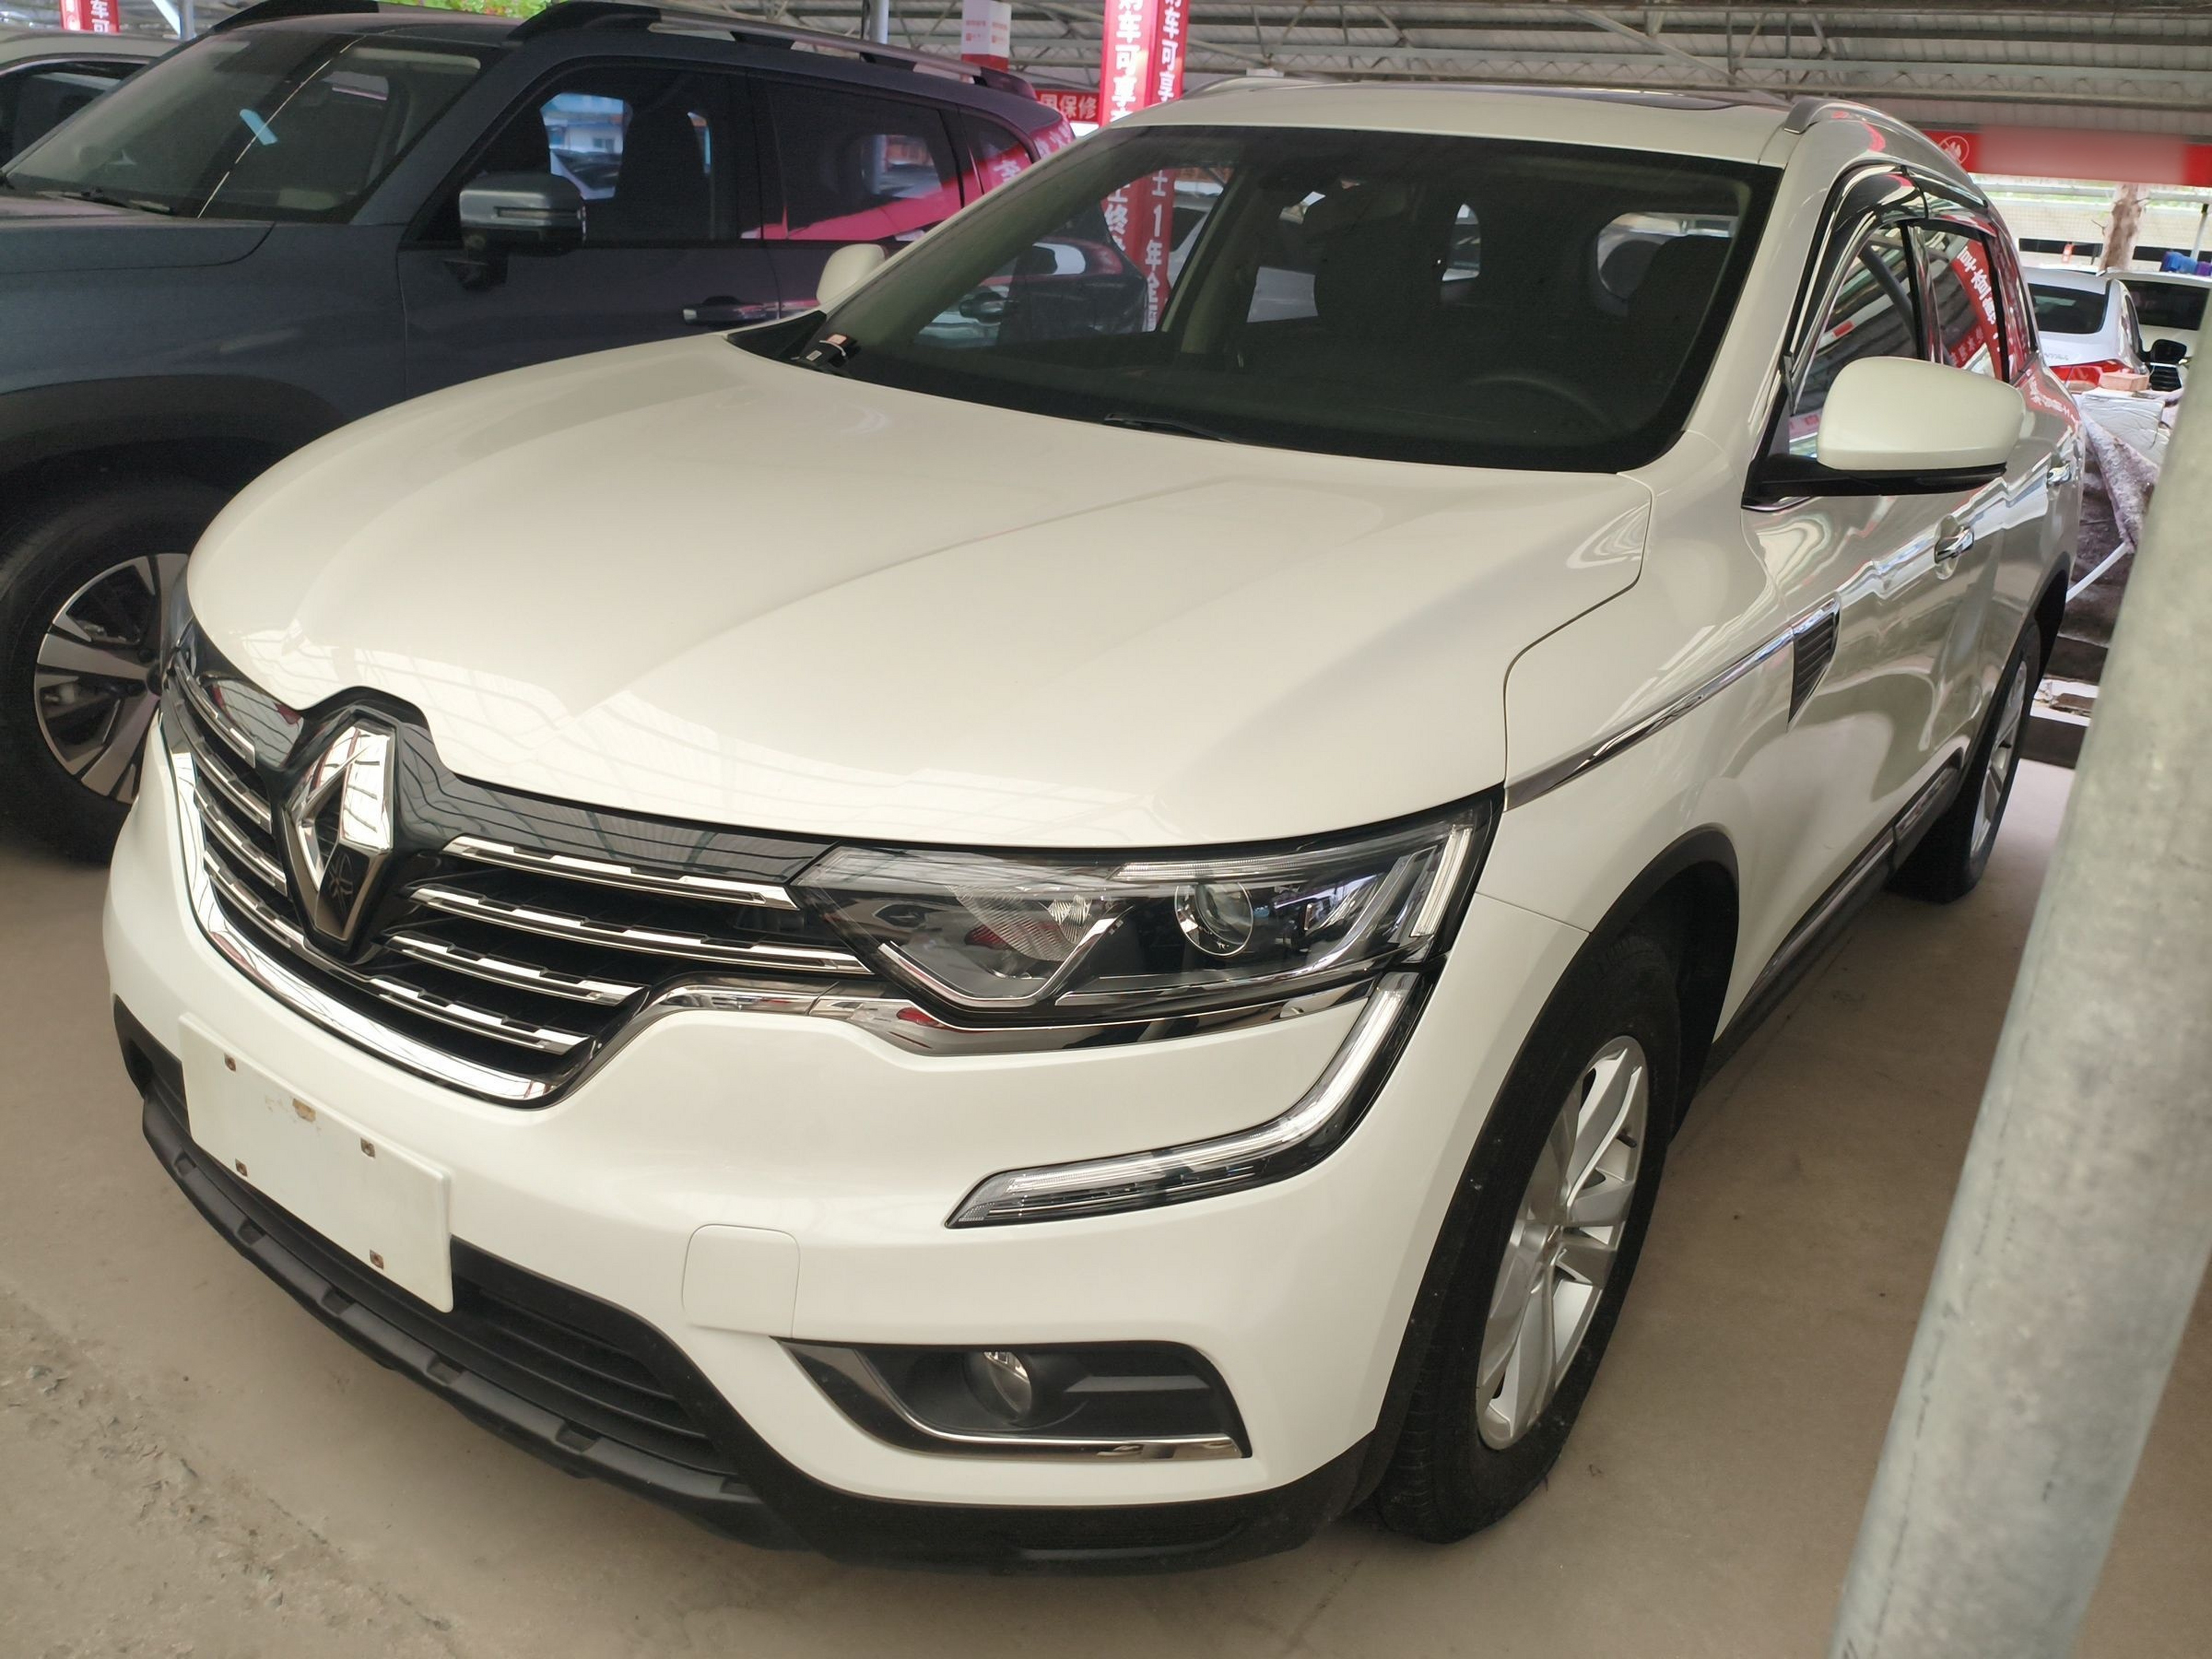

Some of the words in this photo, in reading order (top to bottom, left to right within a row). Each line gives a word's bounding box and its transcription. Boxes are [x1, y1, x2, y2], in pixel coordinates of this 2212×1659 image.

[1109, 0, 1143, 122] 车可享
[1158, 0, 1181, 103] 车可享
